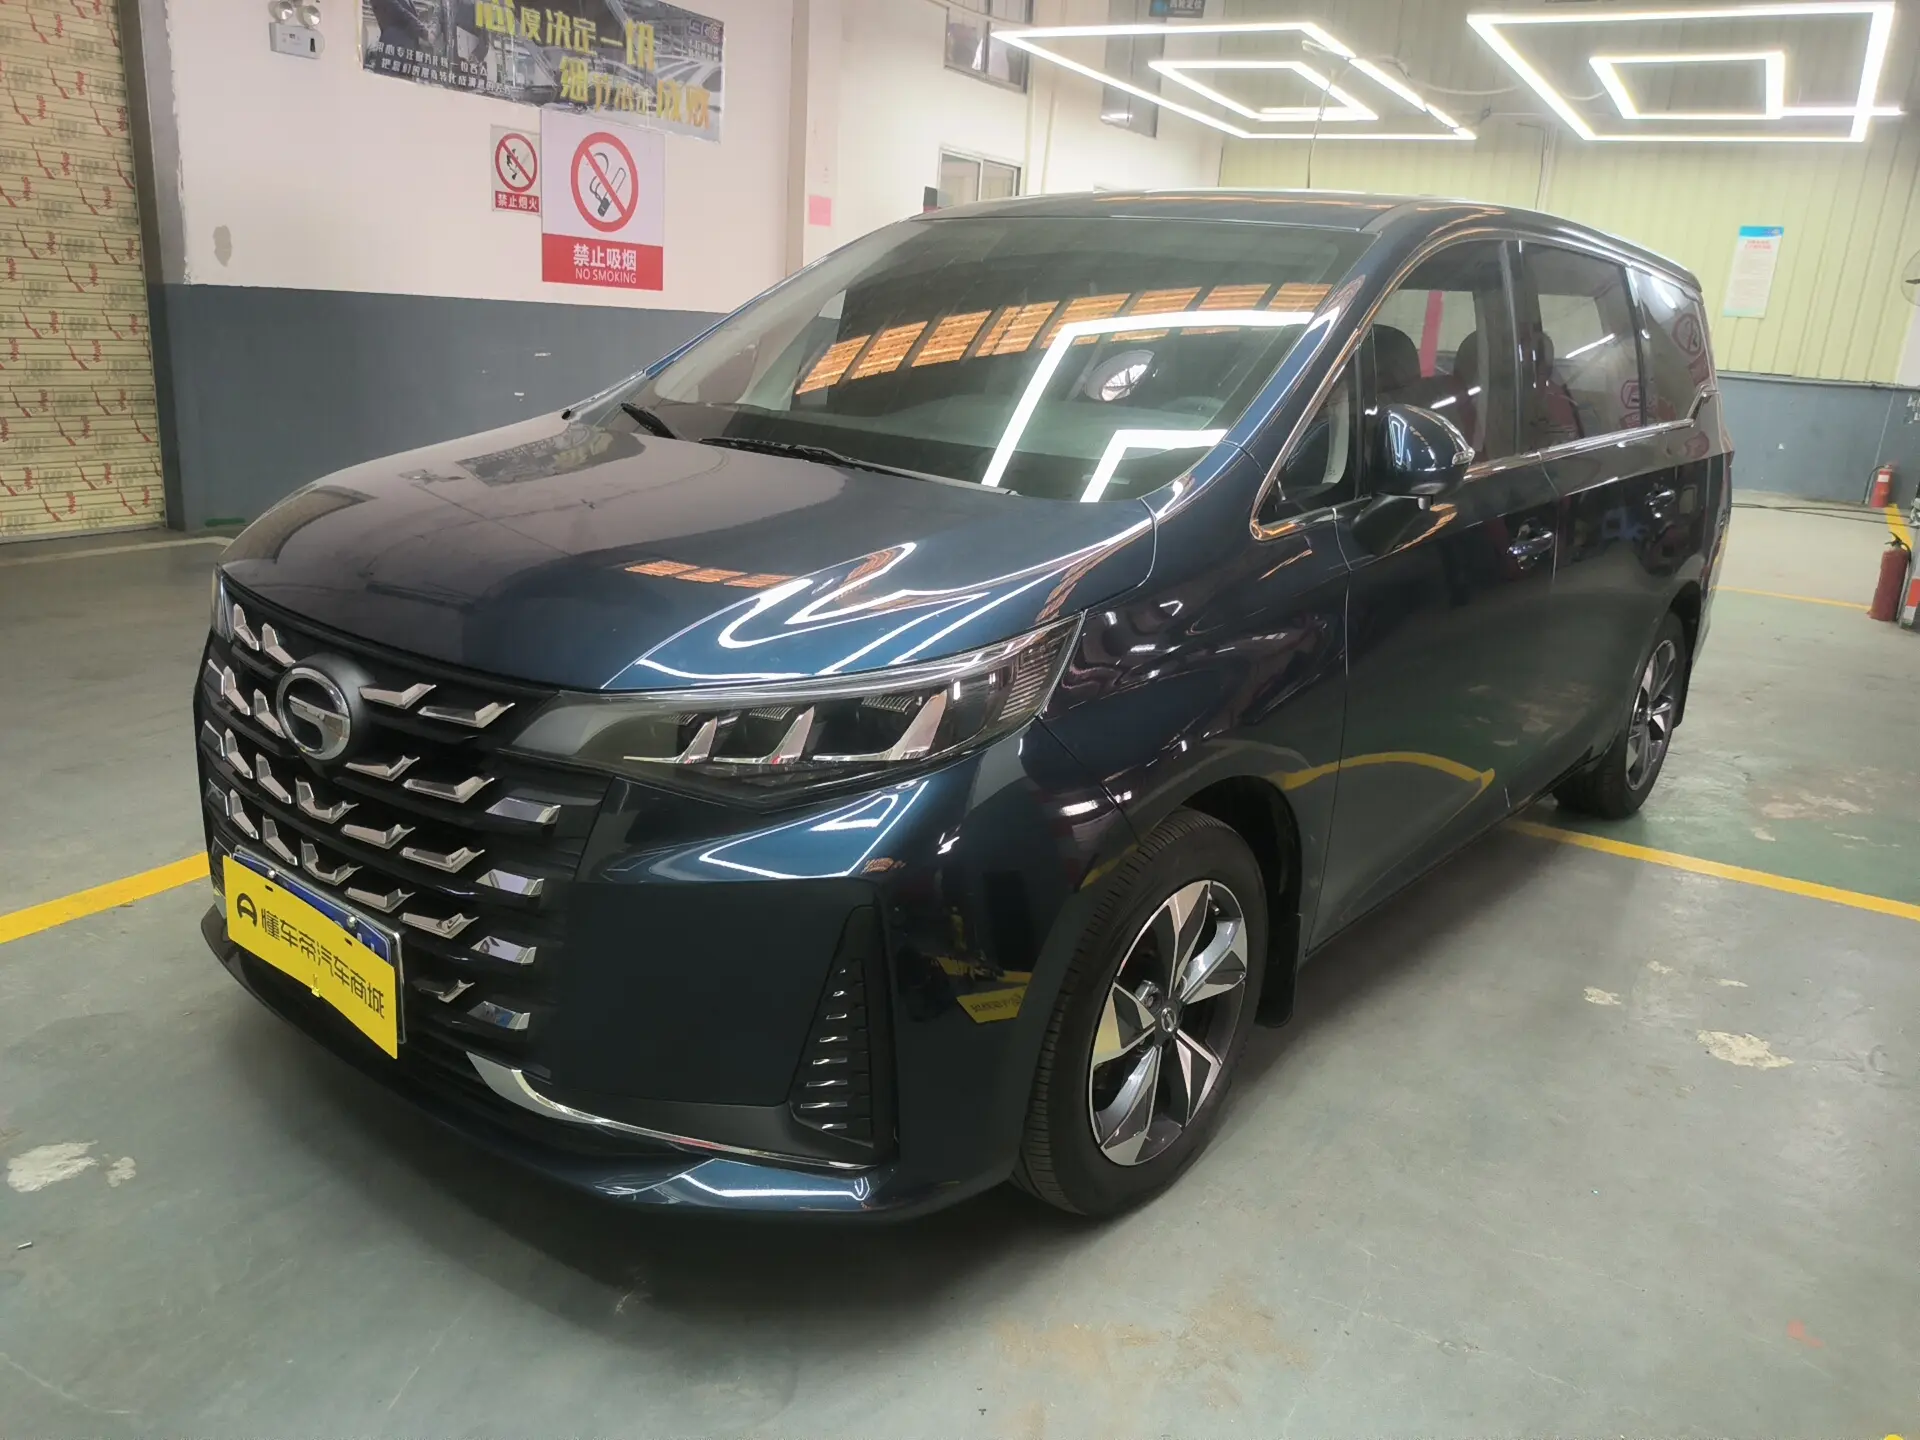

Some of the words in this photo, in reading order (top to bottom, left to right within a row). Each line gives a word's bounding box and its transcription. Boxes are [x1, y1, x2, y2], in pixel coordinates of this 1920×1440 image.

[498, 193, 538, 211] 禁止烟火
[573, 243, 637, 271] 禁止吸烟
[575, 268, 591, 281] NO
[593, 269, 637, 284] SMOKING
[261, 908, 386, 1019] 懂车帝汽车商城
